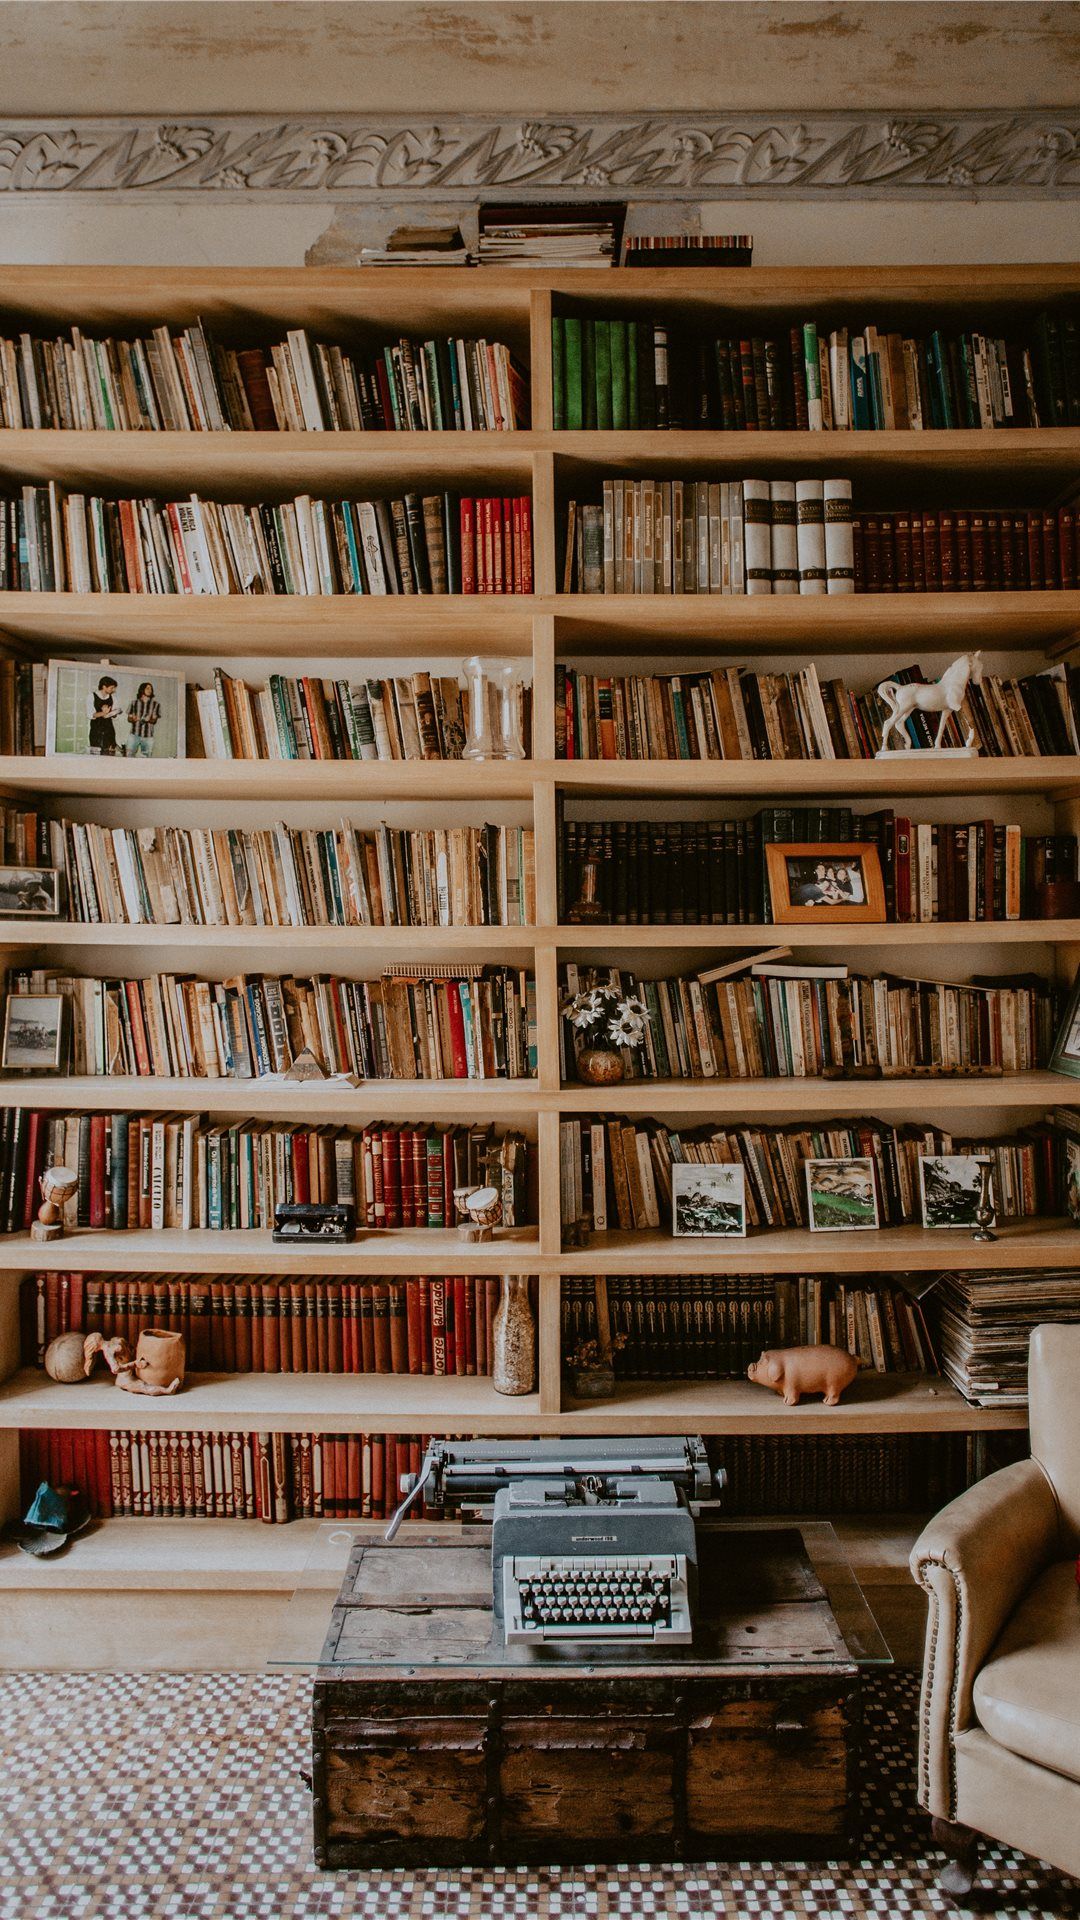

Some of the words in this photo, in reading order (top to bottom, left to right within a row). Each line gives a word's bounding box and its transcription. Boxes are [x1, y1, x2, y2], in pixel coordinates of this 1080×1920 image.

[178, 506, 189, 533] VIOLENTA
[253, 998, 264, 1028] MERCADOS
[433, 1282, 443, 1326] amado
